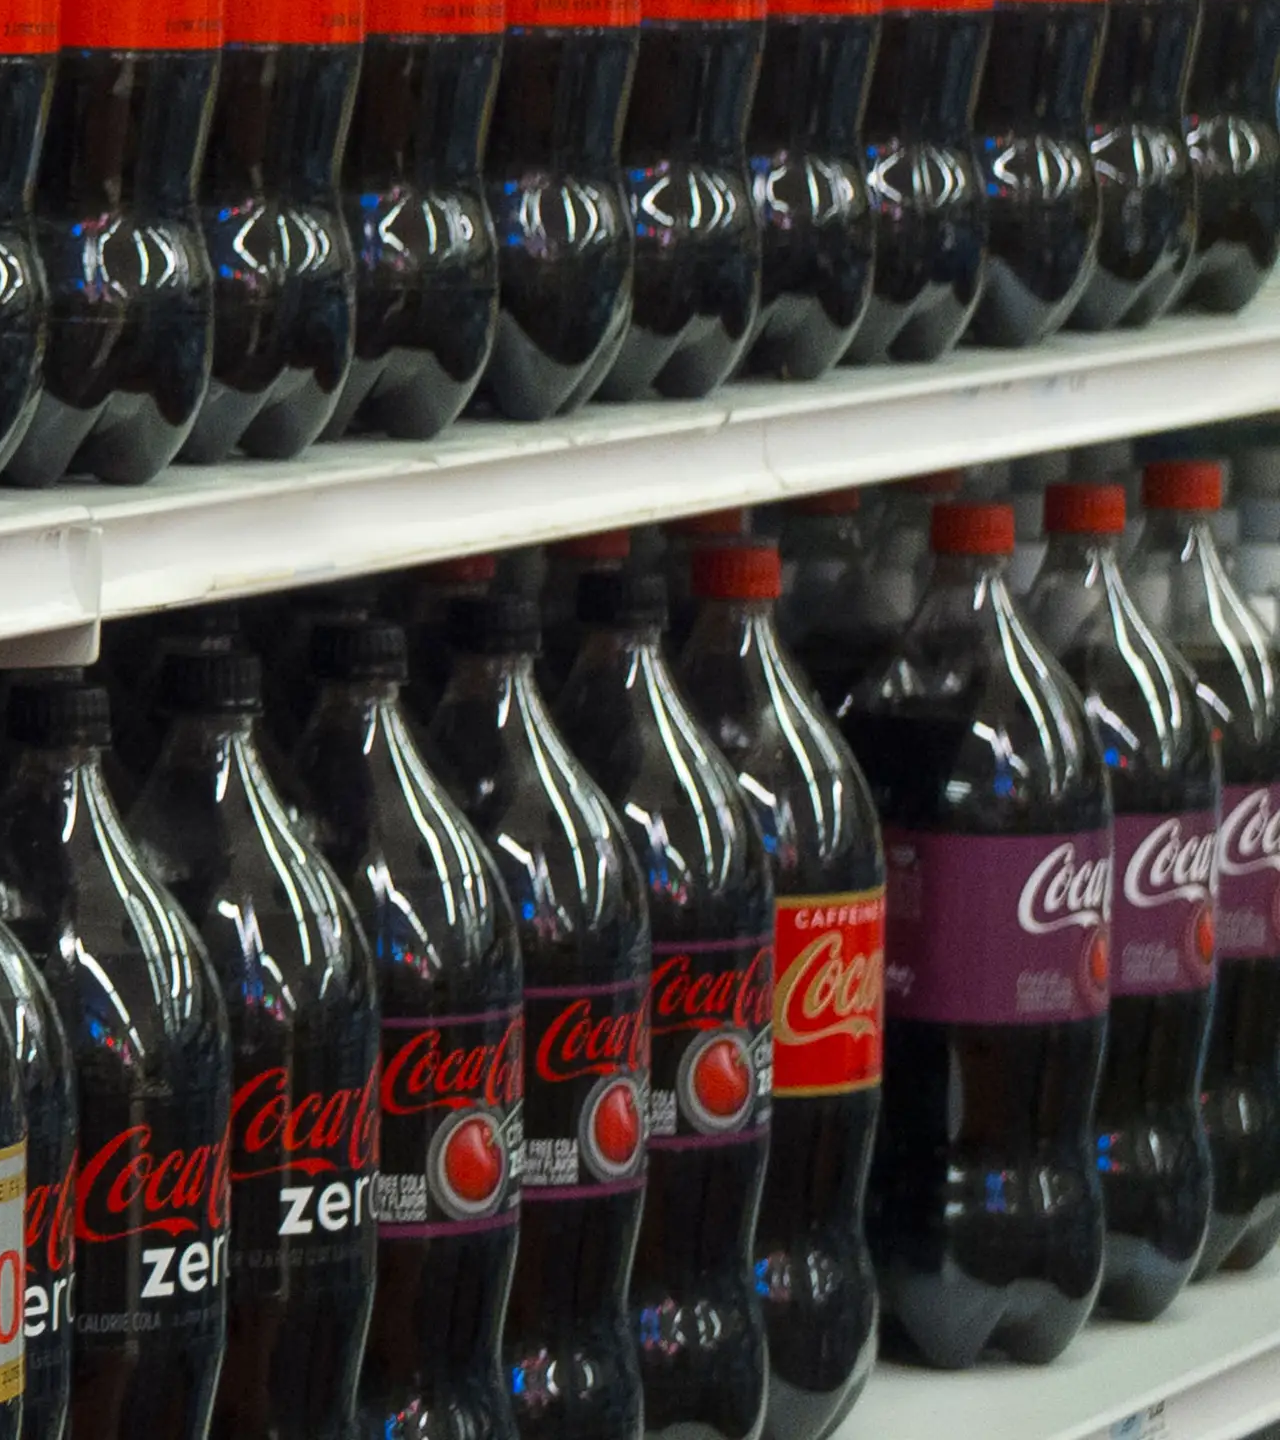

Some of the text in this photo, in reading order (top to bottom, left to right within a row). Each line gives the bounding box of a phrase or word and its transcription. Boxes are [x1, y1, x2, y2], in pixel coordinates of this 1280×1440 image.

[278, 1170, 380, 1236] zer
[140, 1231, 231, 1298] zer
[24, 1272, 77, 1338] er
